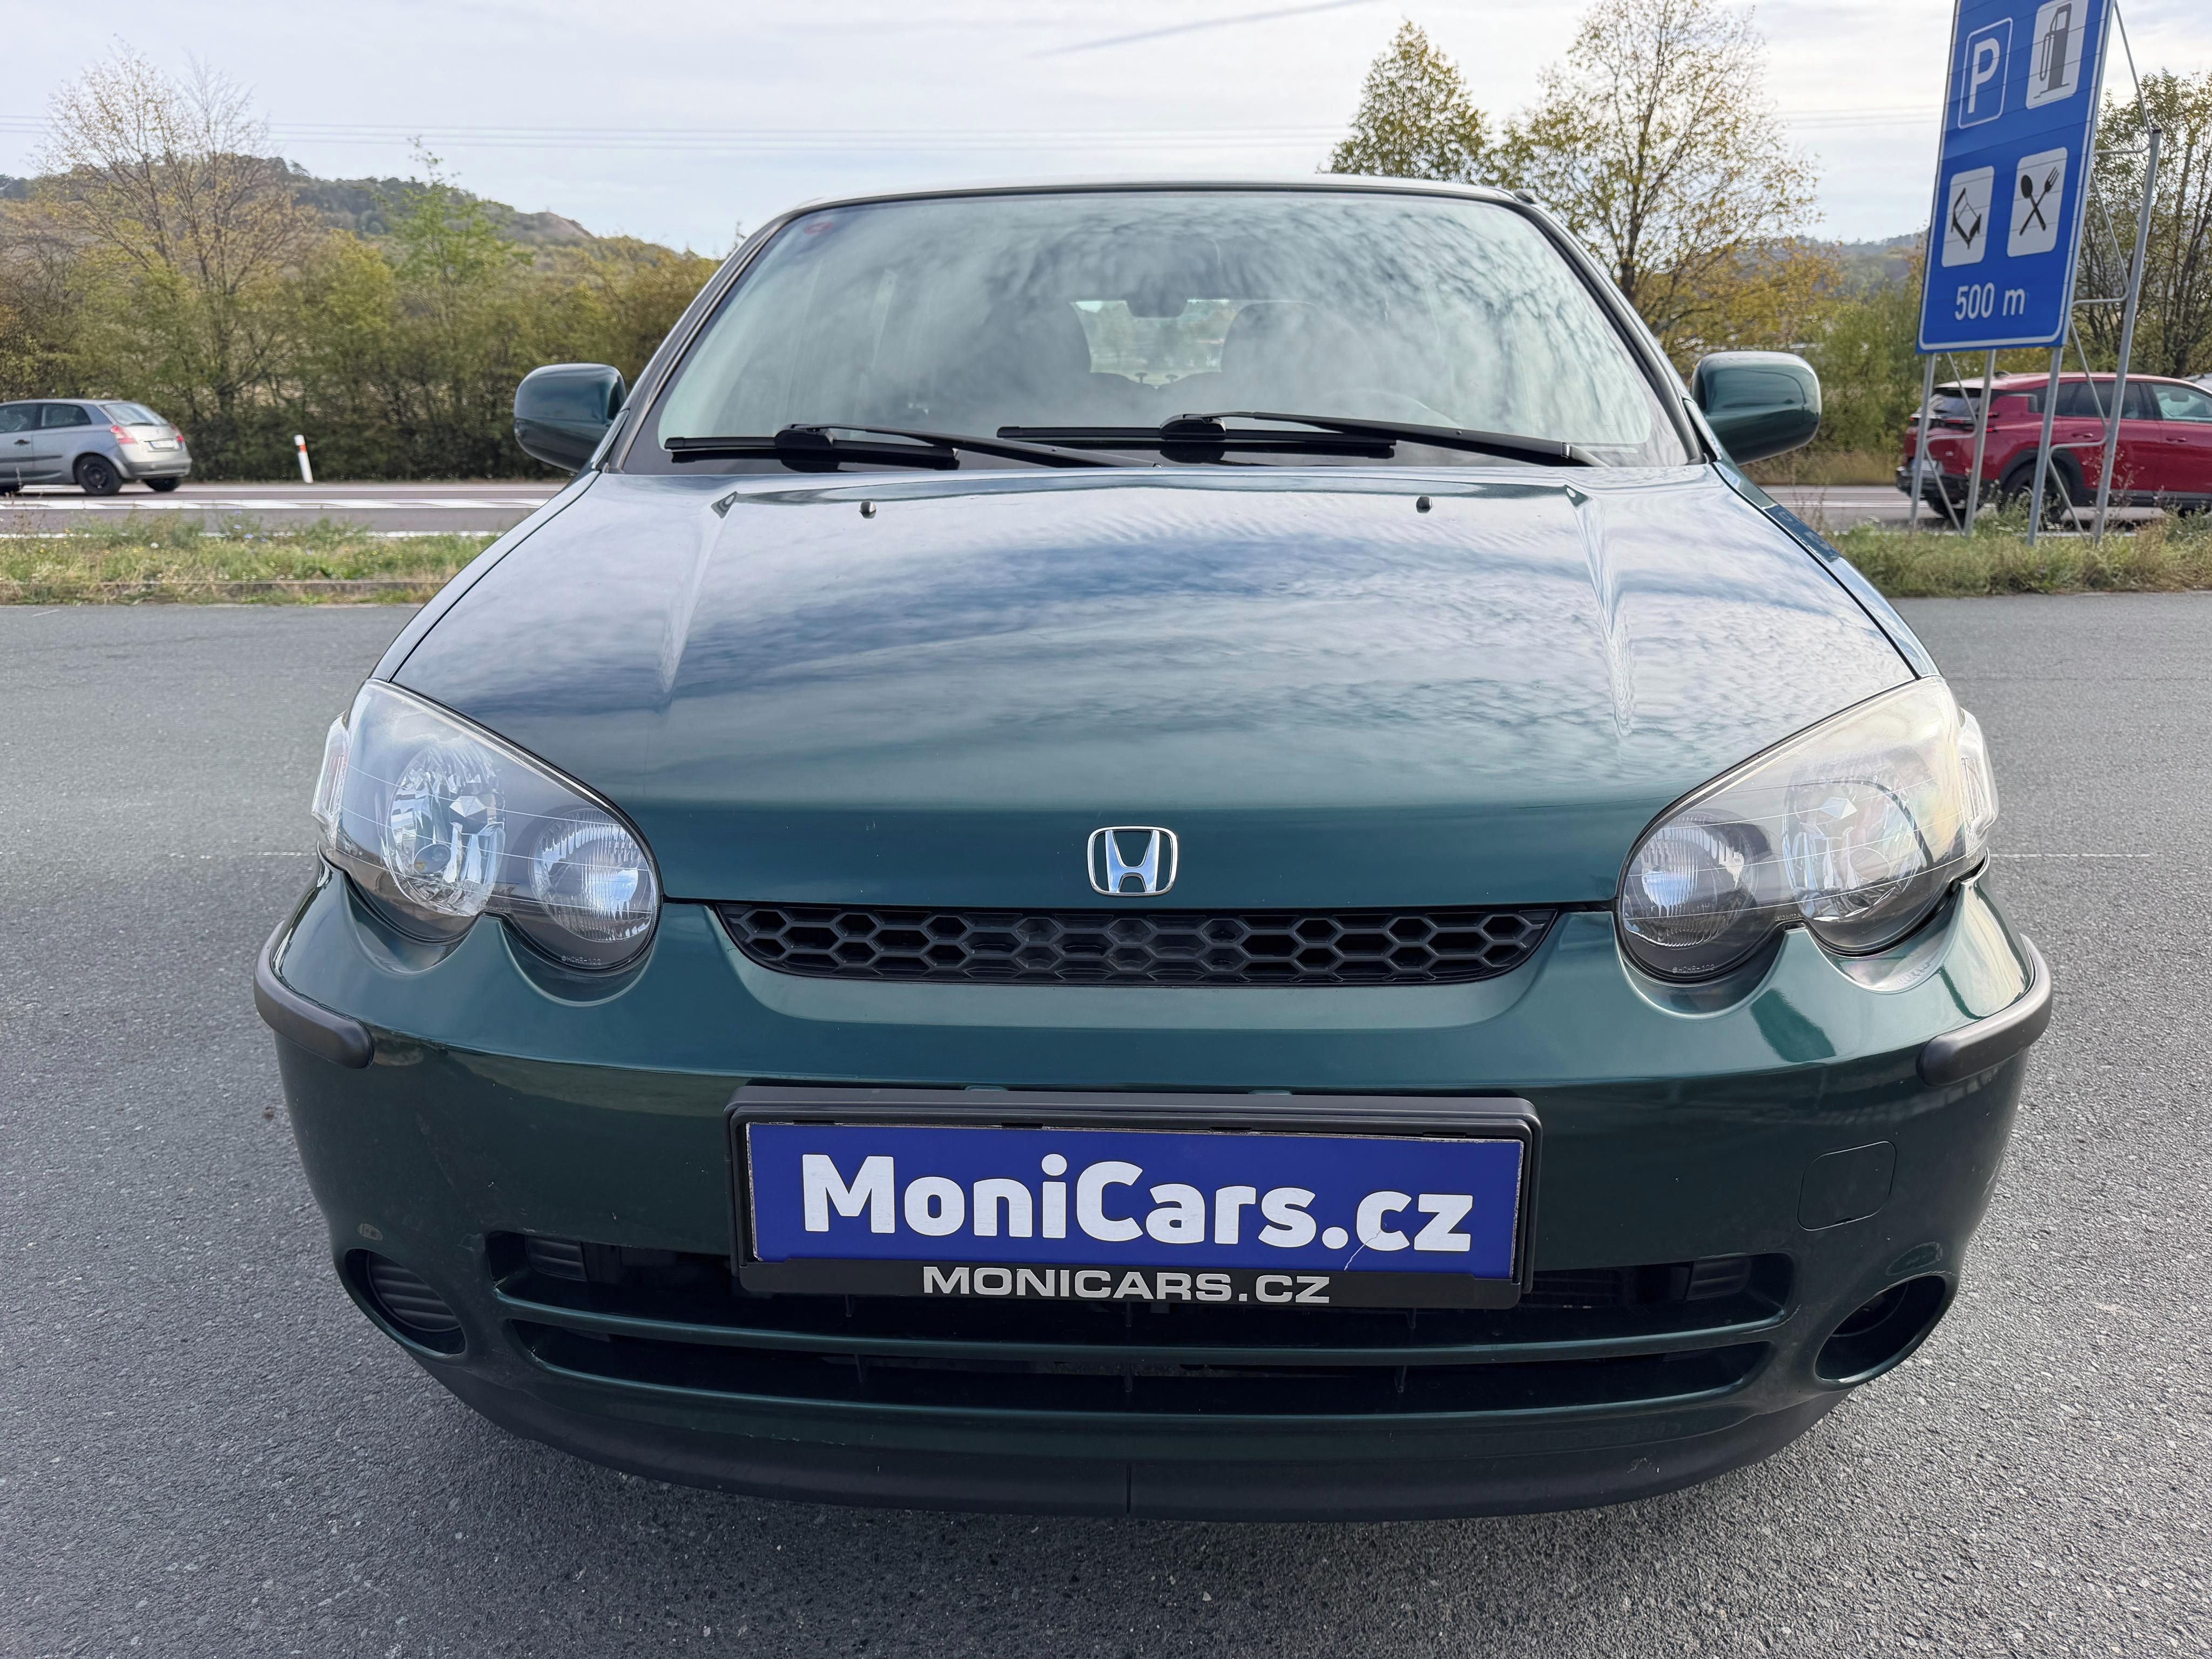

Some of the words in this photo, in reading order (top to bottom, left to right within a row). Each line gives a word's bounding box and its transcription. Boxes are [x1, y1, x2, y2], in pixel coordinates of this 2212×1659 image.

[1967, 37, 2001, 114] P
[1954, 282, 1995, 320] 500
[2002, 287, 2025, 316] m
[802, 1154, 1473, 1252] MoniCars.cz
[923, 1266, 1330, 1304] MONICARS.CZ
